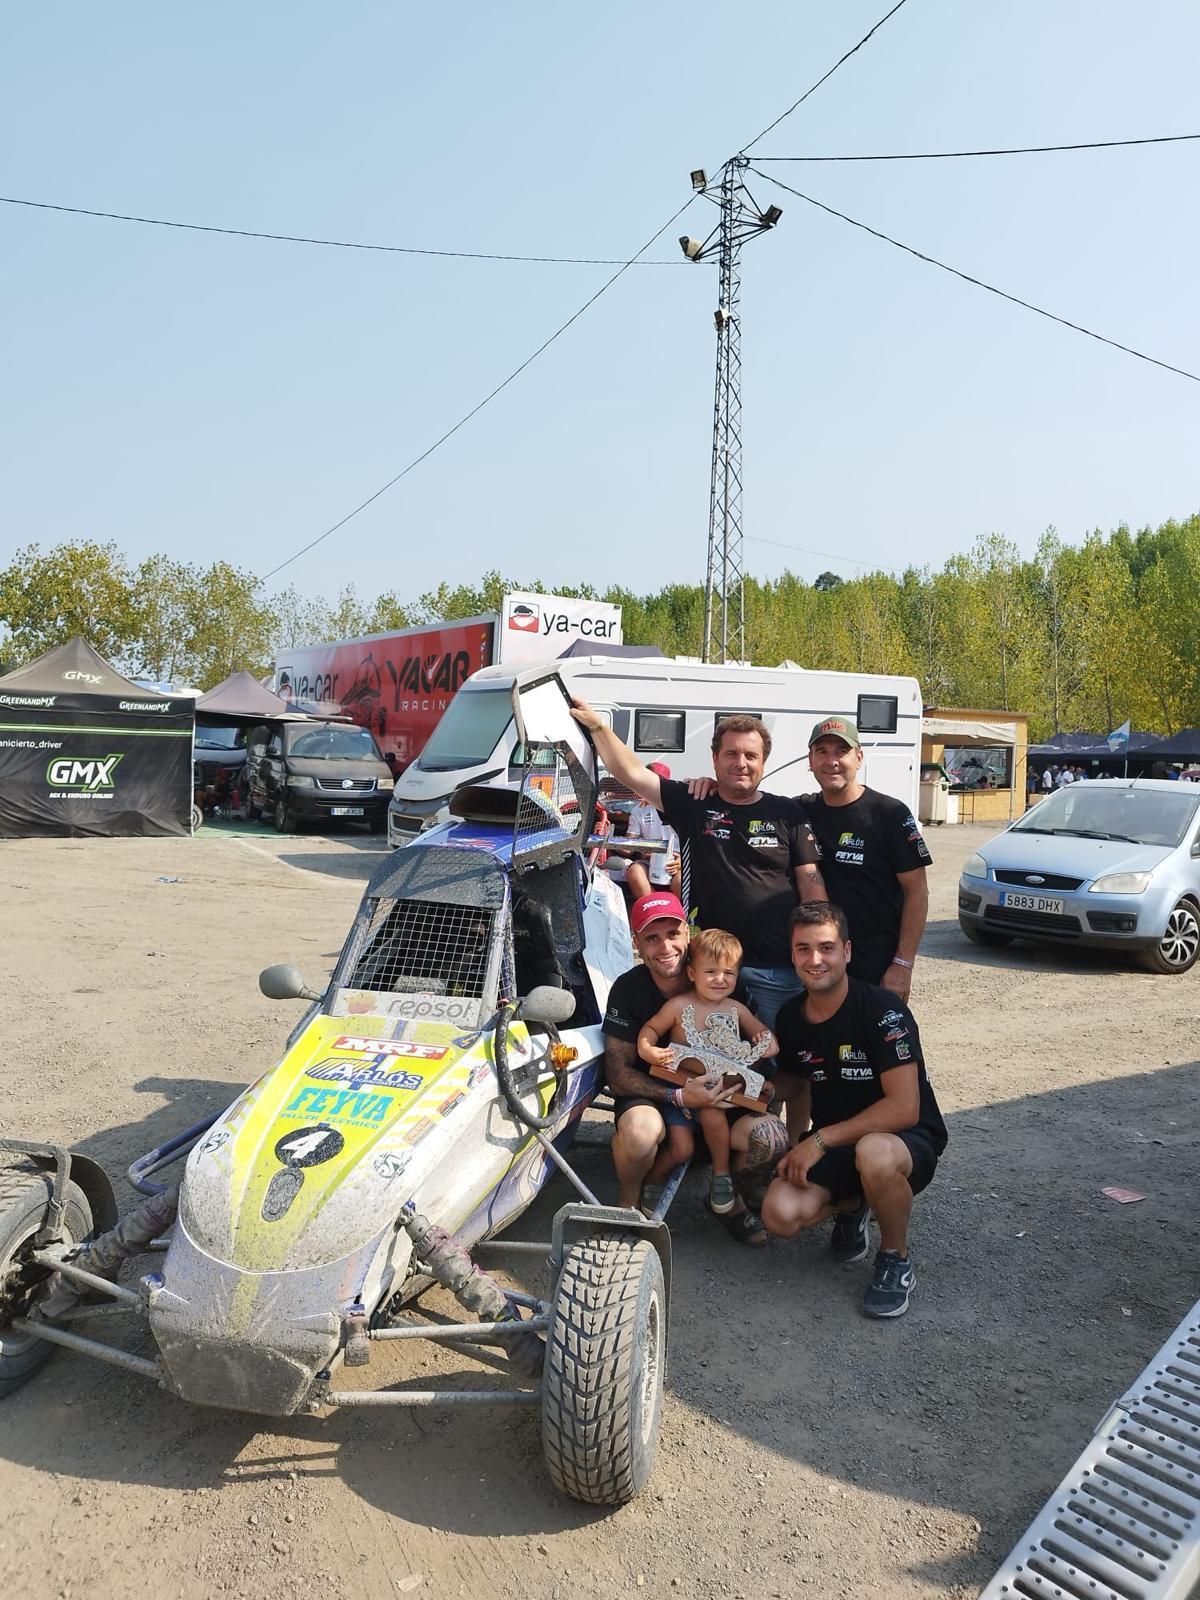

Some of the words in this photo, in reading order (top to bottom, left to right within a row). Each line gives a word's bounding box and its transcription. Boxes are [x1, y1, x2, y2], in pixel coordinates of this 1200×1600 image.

[543, 612, 616, 638] ya-car
[64, 671, 102, 685] GMX
[293, 673, 339, 704] ya-car
[50, 757, 117, 790] GMX
[748, 836, 779, 846] FEYVA
[835, 851, 865, 862] FEYVA
[1007, 895, 1035, 909] 5883
[1038, 899, 1061, 913] DHX
[388, 999, 472, 1021] repsol
[841, 1067, 873, 1077] FEYVA
[286, 1087, 394, 1122] FEYVA
[281, 1131, 332, 1159] 4
